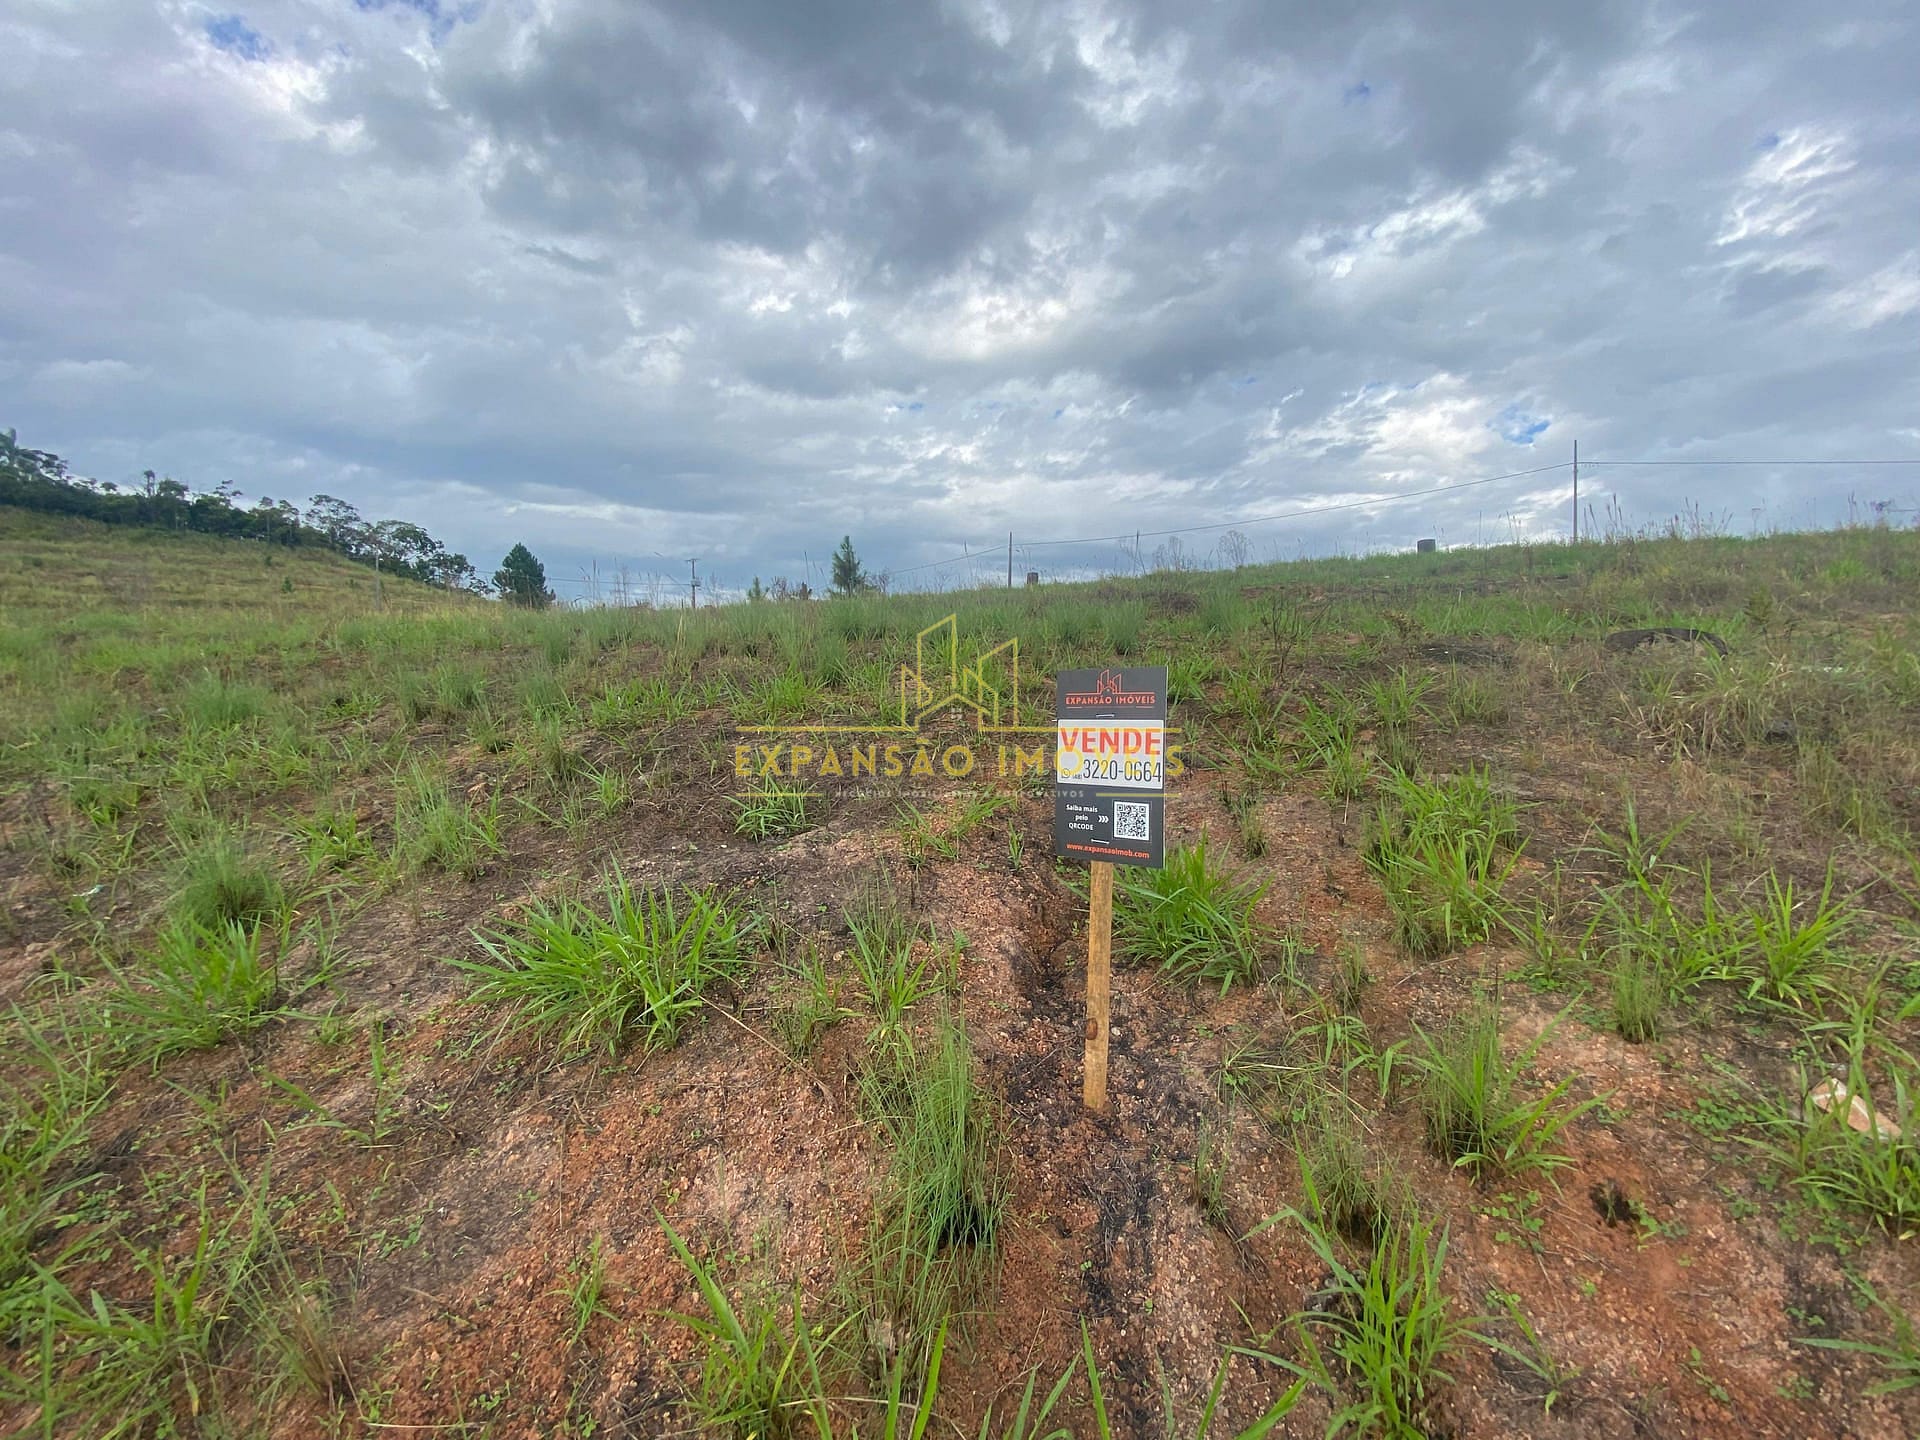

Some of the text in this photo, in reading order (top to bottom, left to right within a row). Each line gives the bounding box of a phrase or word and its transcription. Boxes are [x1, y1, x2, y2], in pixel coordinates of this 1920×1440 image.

[1065, 693, 1156, 705] EXPANSÃO IMÓVEIS
[1060, 727, 1161, 755] VENDE
[1083, 759, 1162, 782] 3220-0664
[1066, 804, 1098, 813] Saiba mais
[1068, 822, 1095, 831] QRCODE
